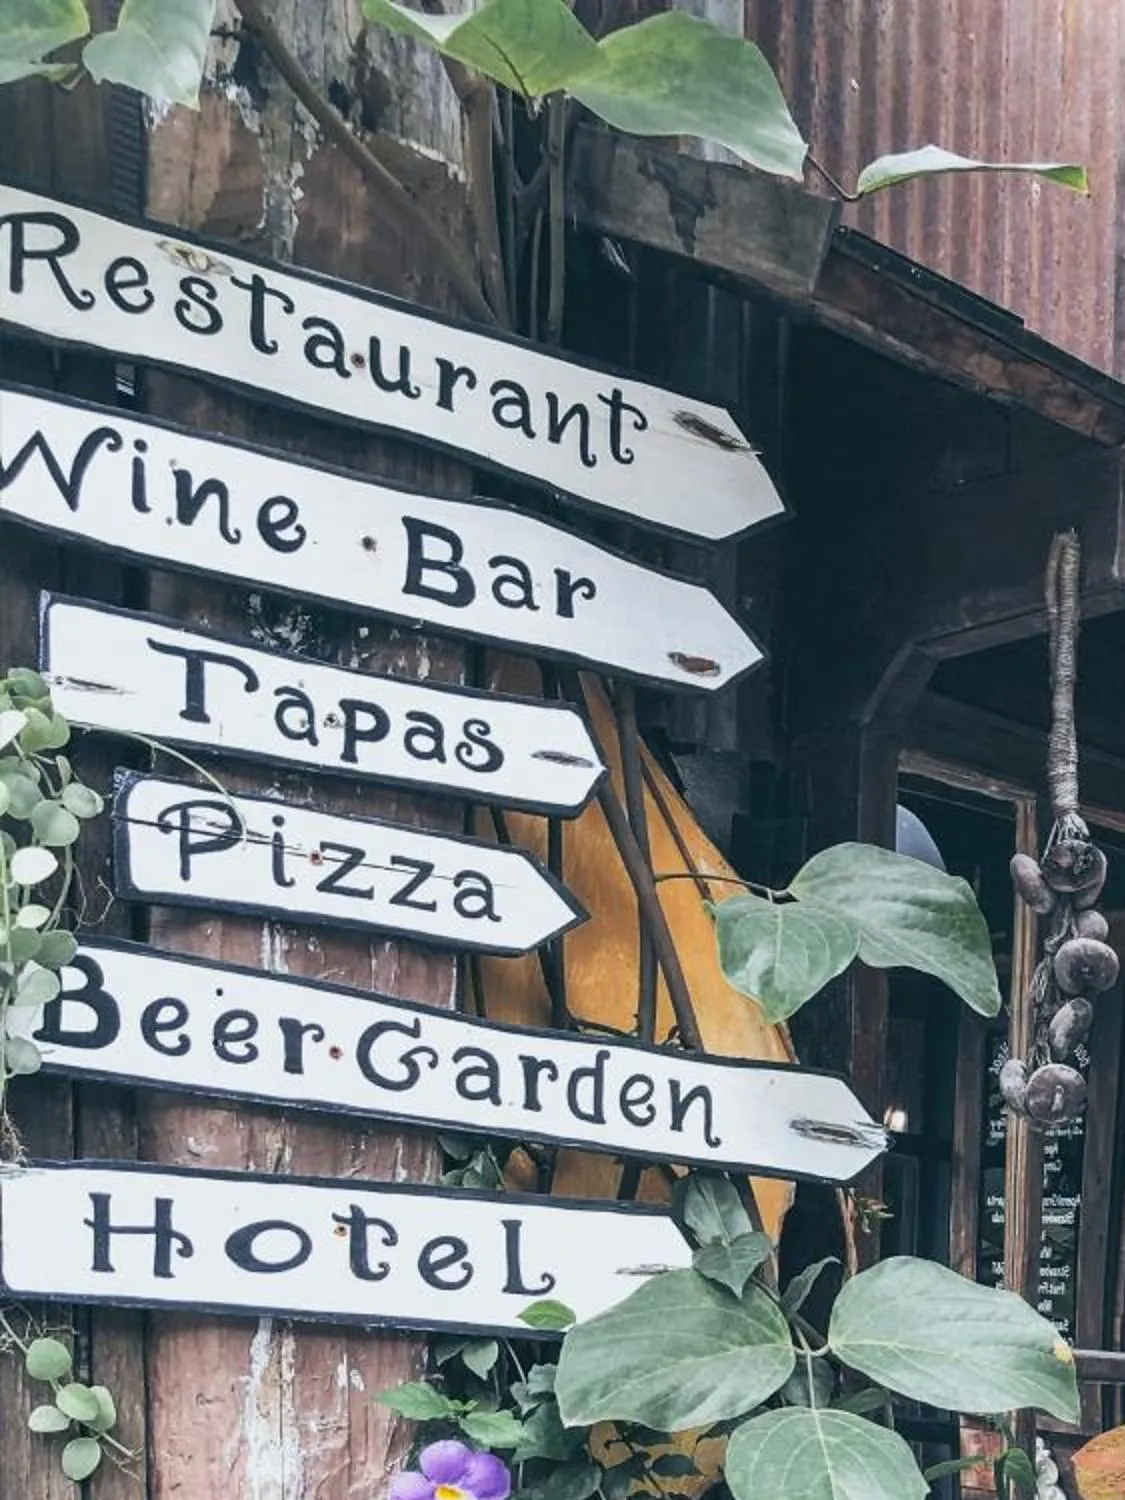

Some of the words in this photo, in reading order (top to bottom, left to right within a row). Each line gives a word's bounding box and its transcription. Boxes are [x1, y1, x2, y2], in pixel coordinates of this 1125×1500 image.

[0, 211, 648, 468] Restaurant
[0, 427, 307, 553] Wine
[402, 514, 597, 620] Bar
[147, 637, 502, 772] Tapas
[158, 799, 502, 923] Pizza
[33, 953, 324, 1075] Beer
[356, 1016, 722, 1148] Garden
